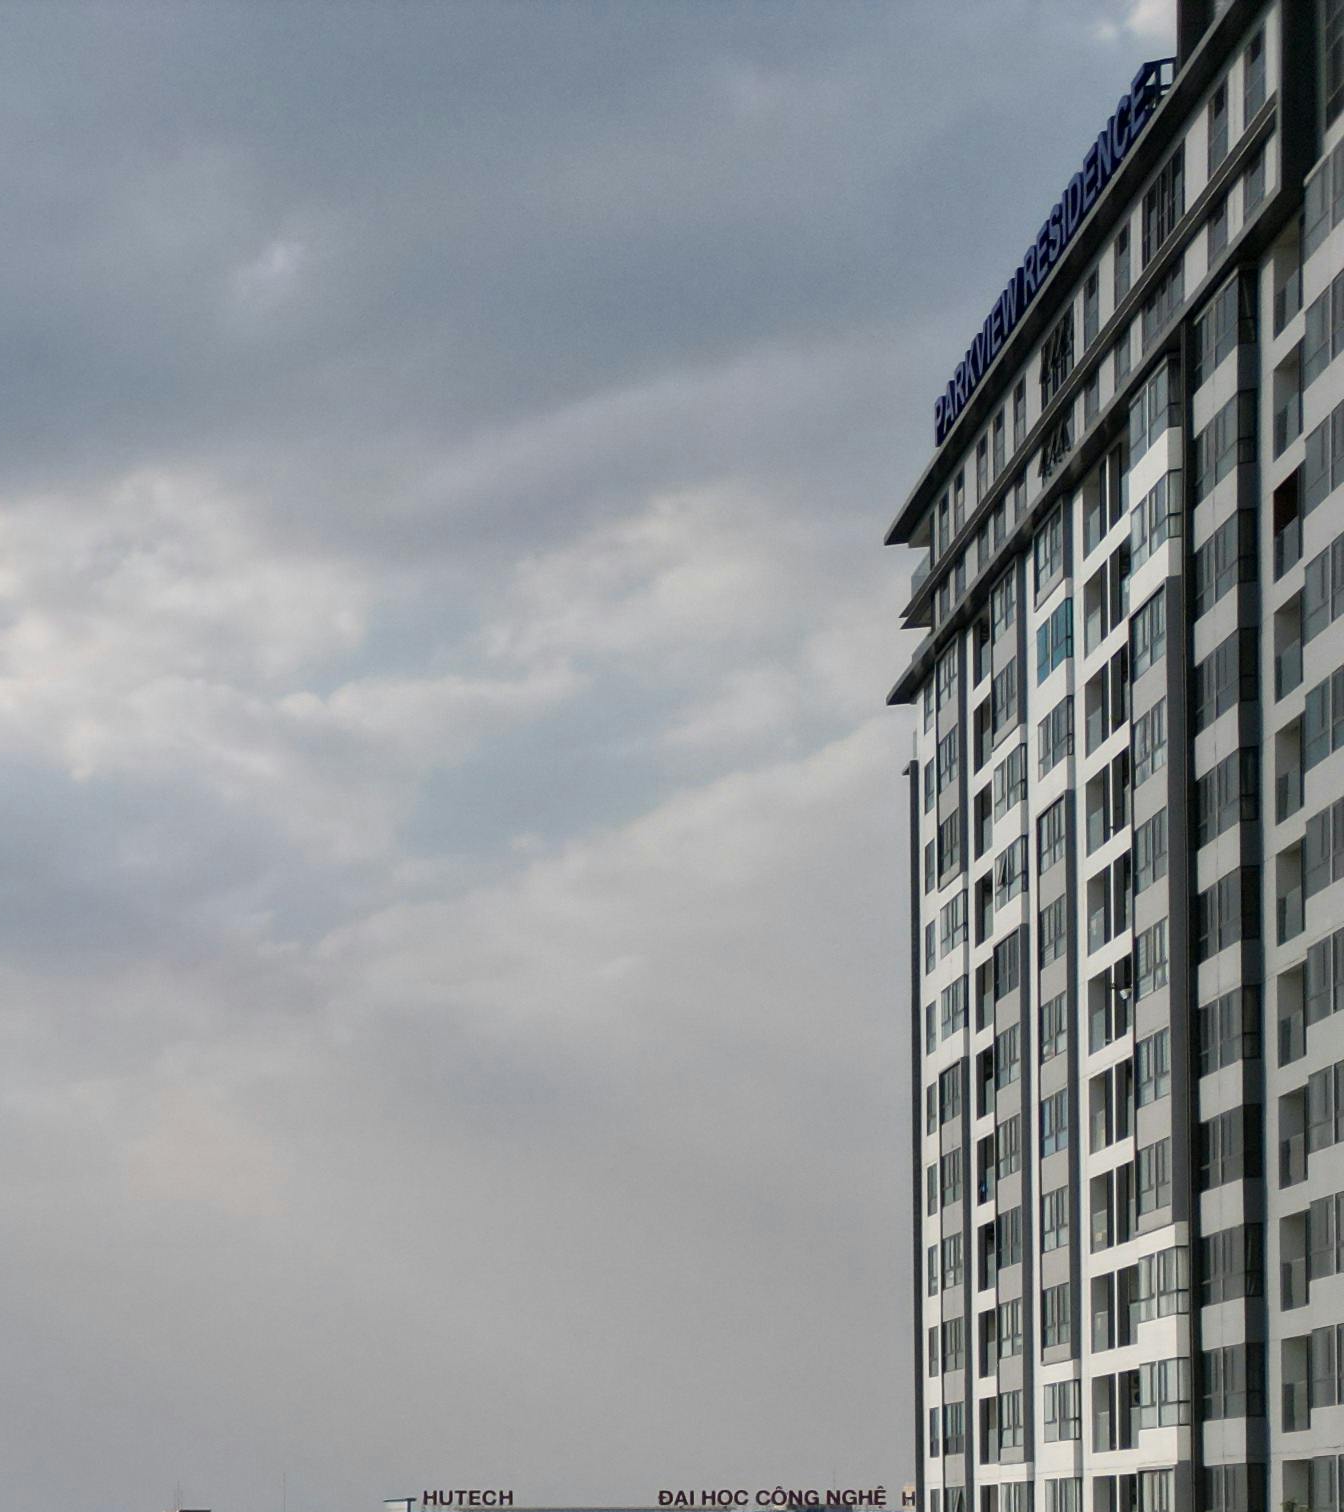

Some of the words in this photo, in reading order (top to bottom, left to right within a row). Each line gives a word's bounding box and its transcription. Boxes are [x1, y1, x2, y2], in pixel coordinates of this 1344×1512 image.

[934, 267, 1025, 448] PARKVIEW
[1023, 63, 1154, 307] RESIDENCE
[423, 1490, 513, 1506] HUTECH
[658, 1489, 695, 1508] ĐẠI
[703, 1489, 749, 1509] HỌC
[755, 1486, 819, 1506] CÔNG
[827, 1485, 886, 1509] NGHỆ
